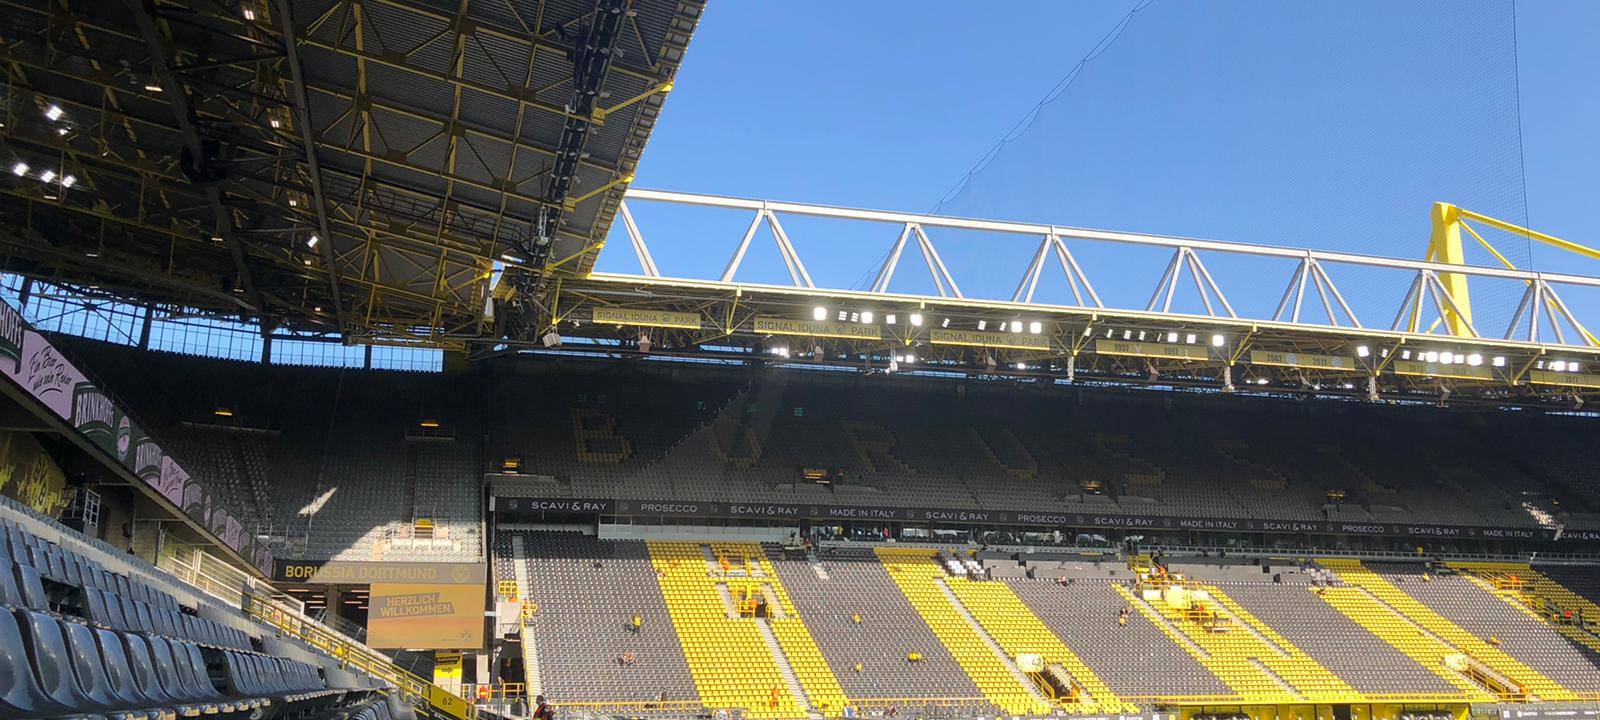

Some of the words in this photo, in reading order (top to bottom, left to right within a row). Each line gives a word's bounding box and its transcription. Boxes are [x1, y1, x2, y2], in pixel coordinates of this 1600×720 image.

[597, 310, 629, 321] SIGNAL
[630, 313, 658, 323] IDUNA
[674, 316, 698, 325] PARK
[756, 320, 794, 331] SIGNAL
[796, 323, 830, 335] IDUNA
[851, 326, 880, 337] PARK
[933, 331, 971, 342] SIGNAL
[972, 334, 1001, 345] IDUNA
[1021, 337, 1048, 347] PARK
[531, 501, 569, 510] SCAVI
[583, 502, 607, 511] RAY
[640, 503, 698, 513] PROSECCO
[730, 505, 765, 514] SCAVI
[777, 507, 799, 515] RAY
[830, 508, 856, 517] MADE
[858, 509, 868, 517] IN
[870, 509, 896, 518] ITALY
[926, 511, 958, 520] SCAVI
[969, 512, 989, 521] RAY
[1017, 514, 1066, 524] PROSECCO
[1094, 517, 1126, 526] SCAVI
[1135, 518, 1154, 527] RAY
[1180, 520, 1203, 528] MADE
[1215, 521, 1238, 529] ITALY
[1264, 522, 1291, 531] SCAVI
[1300, 523, 1318, 532] RAY
[1342, 525, 1385, 533] PROSECCO
[1408, 527, 1435, 535] SCAVI
[1444, 527, 1460, 536] RAY
[1483, 529, 1504, 538] MADE
[1505, 530, 1513, 538] IN
[1514, 530, 1534, 539] ITALY
[1561, 532, 1581, 540] CAVI
[285, 564, 354, 579] BORUSSIA
[359, 566, 437, 580] DORTMUND
[387, 594, 436, 607] HERZLICH
[380, 604, 451, 617] WILLKOMMEN
[442, 697, 453, 705] 62
